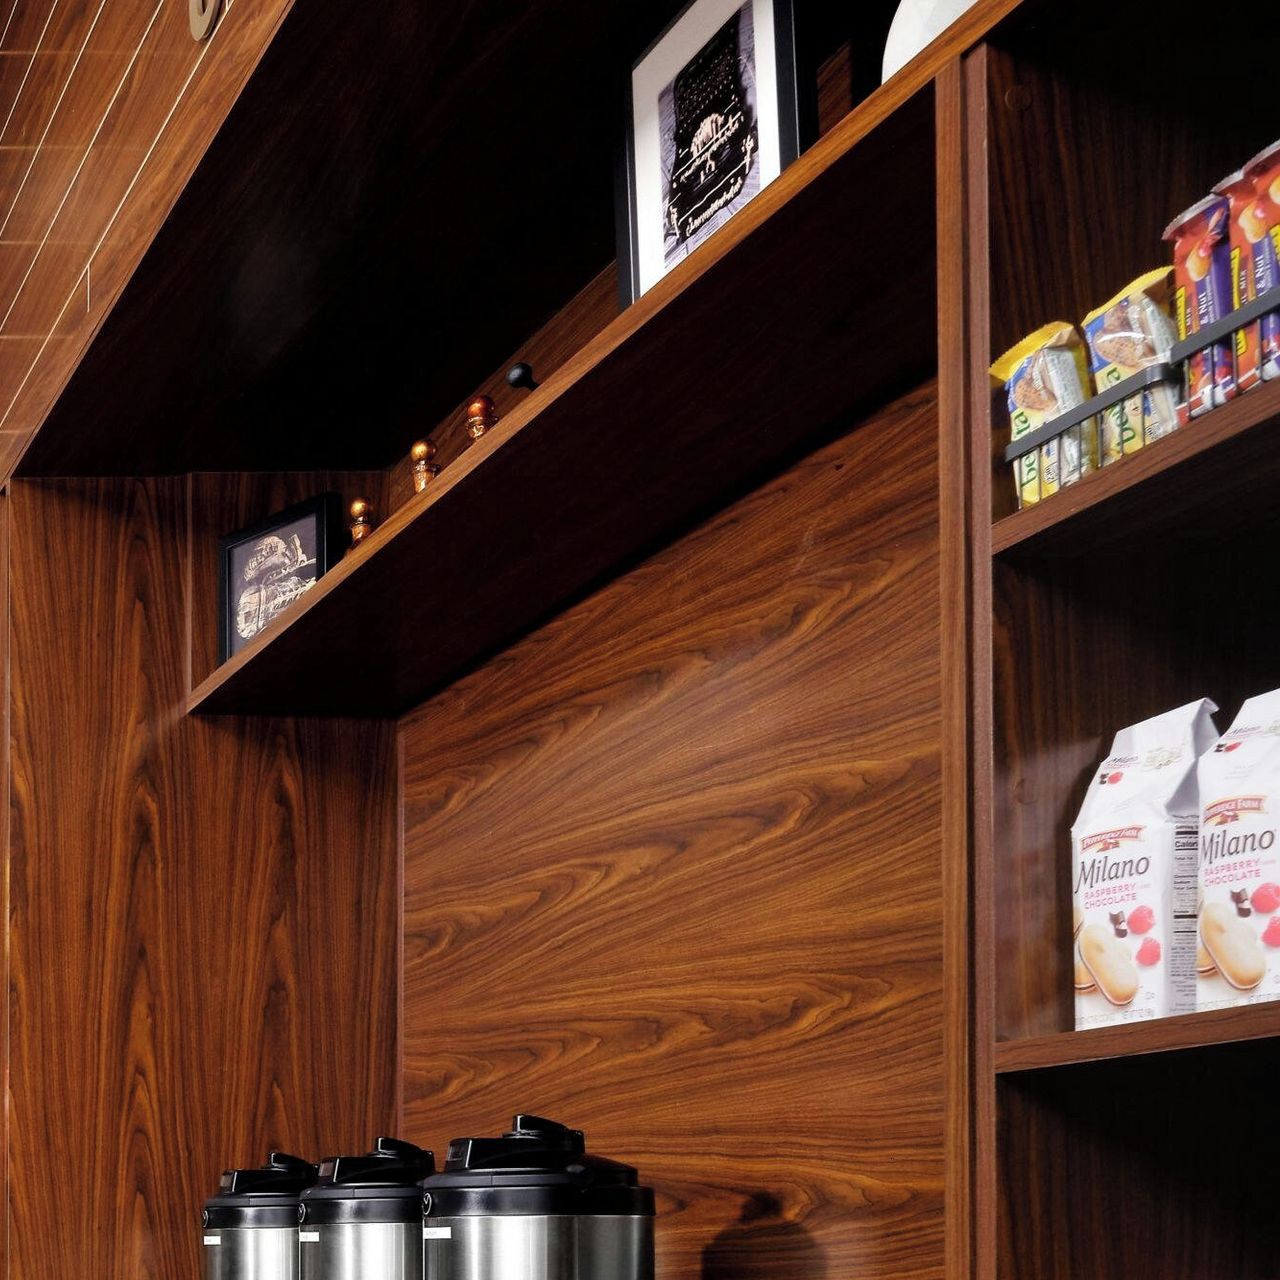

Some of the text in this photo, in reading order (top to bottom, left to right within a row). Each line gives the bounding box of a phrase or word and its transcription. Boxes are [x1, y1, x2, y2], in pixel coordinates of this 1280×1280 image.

[1201, 829, 1275, 865] Milano
[1074, 856, 1150, 894] Milano
[1084, 882, 1137, 900] RASPBERRY
[1084, 893, 1137, 910] CHOCOLATE
